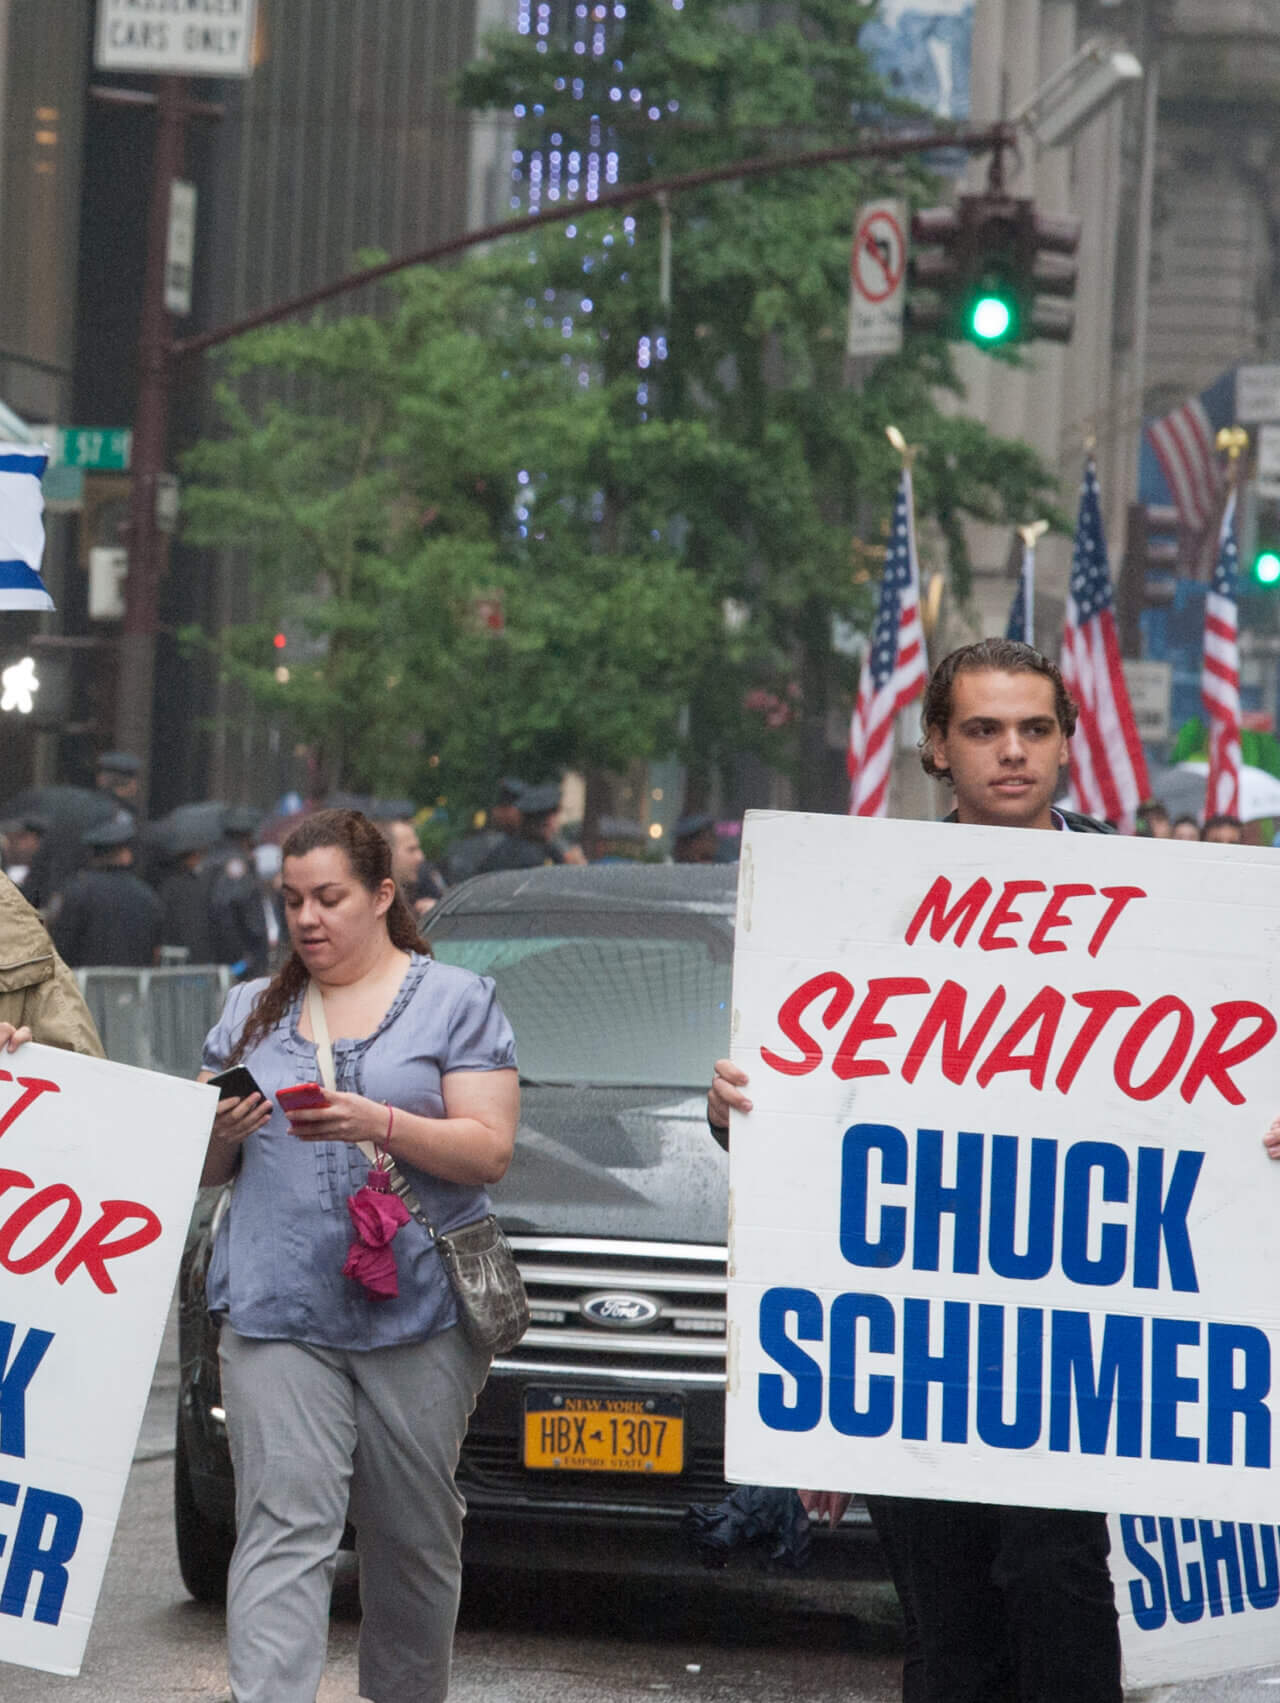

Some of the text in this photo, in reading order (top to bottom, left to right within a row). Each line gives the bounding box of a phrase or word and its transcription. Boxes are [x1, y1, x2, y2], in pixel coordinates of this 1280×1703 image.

[111, 20, 239, 55] CARS ONLY
[904, 875, 1147, 958] MEET
[760, 971, 1278, 1106] SENATOR
[839, 1122, 1206, 1293] CHUCK
[600, 1300, 641, 1319] Ford
[565, 1399, 645, 1413] NEW YORK
[757, 1286, 1272, 1469] SCHUMER
[541, 1416, 668, 1459] HBX 1307
[610, 1458, 643, 1469] STATE
[1119, 1513, 1280, 1631] SCHU
